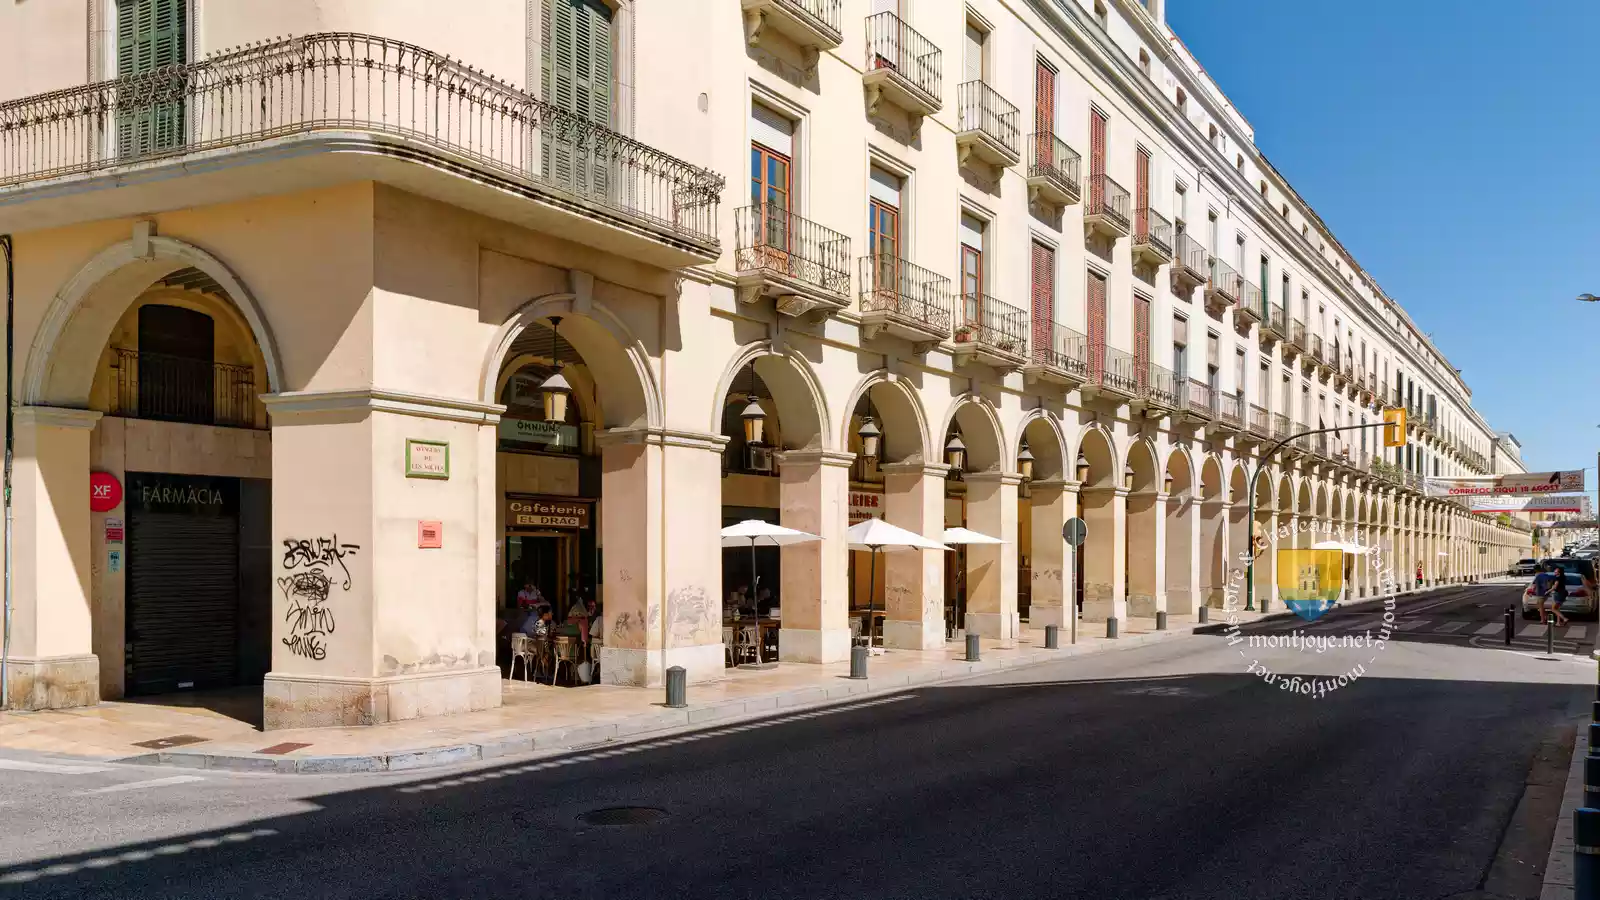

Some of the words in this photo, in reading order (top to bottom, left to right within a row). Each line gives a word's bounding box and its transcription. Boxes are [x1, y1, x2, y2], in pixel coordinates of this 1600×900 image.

[93, 484, 112, 496] XF
[1531, 484, 1561, 492] AGOST
[510, 502, 586, 516] Cafeteria
[519, 515, 535, 525] EL
[540, 516, 577, 525] DRAC
